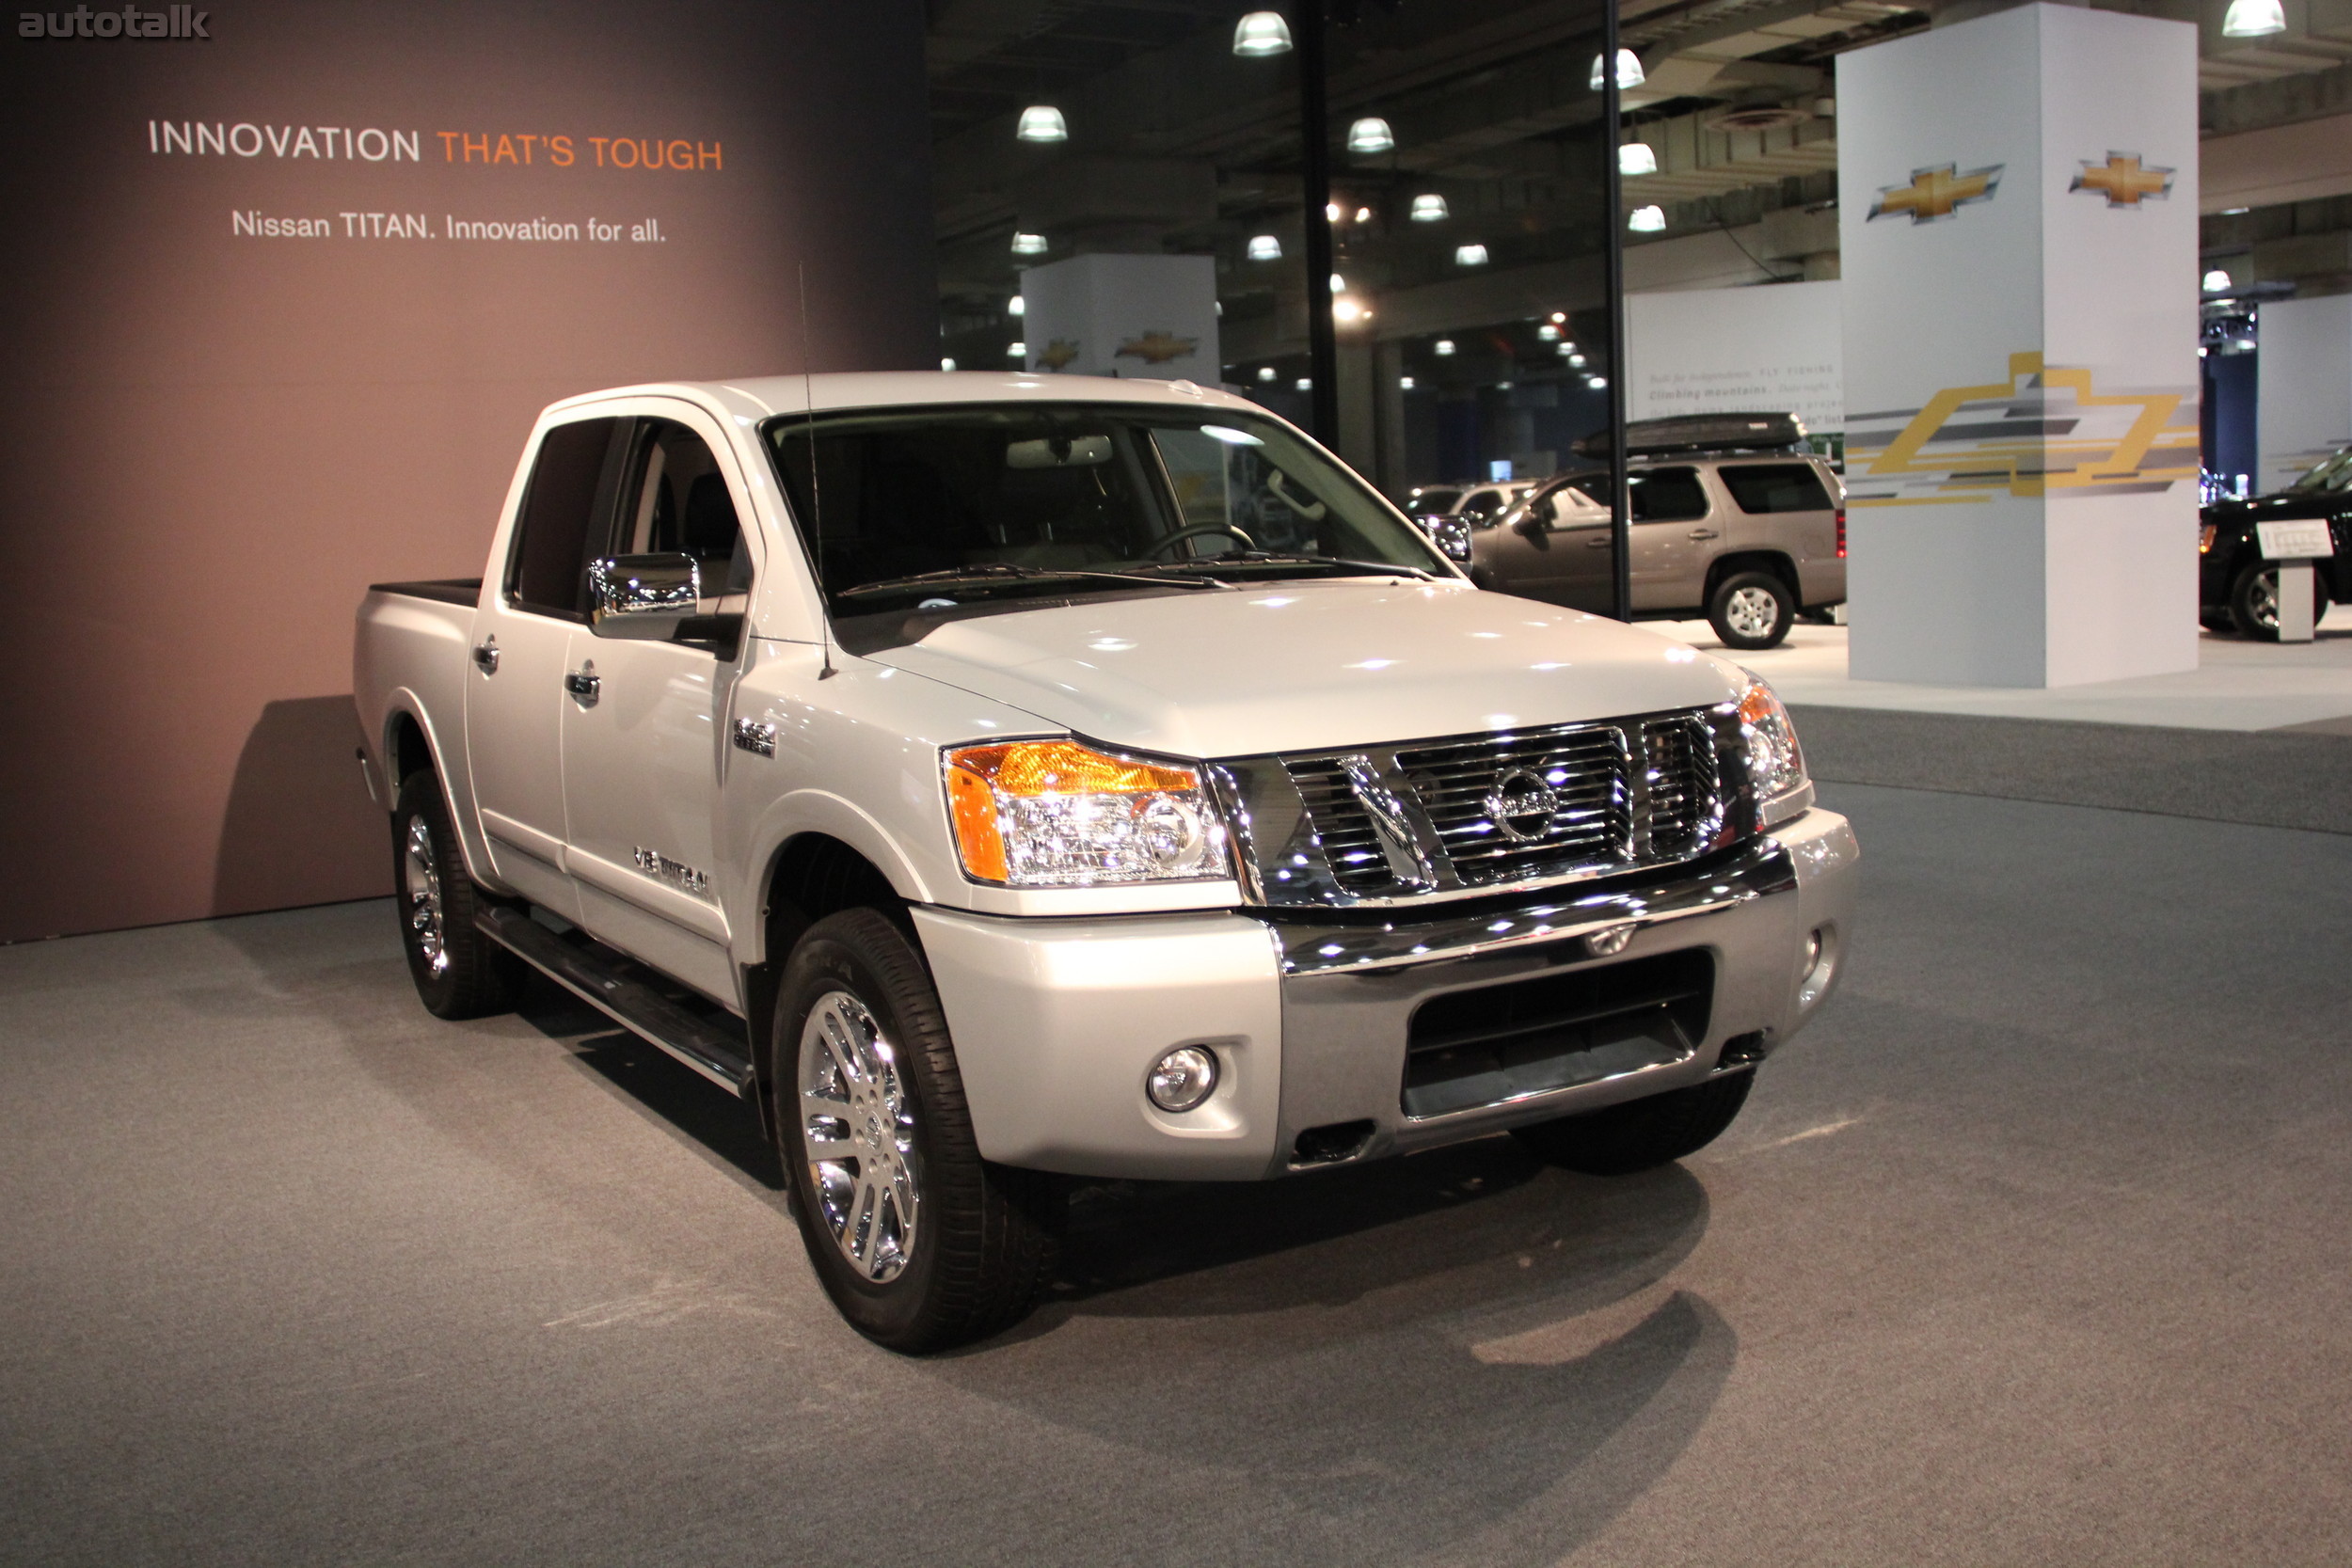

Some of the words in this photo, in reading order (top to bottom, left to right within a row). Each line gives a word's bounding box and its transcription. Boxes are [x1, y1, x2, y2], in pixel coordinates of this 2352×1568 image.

[149, 119, 420, 162] INNOVATION
[437, 131, 576, 167] THAT'S
[588, 137, 723, 171] TOUGH
[231, 209, 330, 237] Nissan
[340, 212, 436, 239] TITAN.
[447, 214, 579, 241] Innovation
[587, 216, 623, 242] for
[631, 217, 666, 243] all.
[1787, 363, 1834, 376] FISHING
[1649, 388, 1701, 402] Climbing
[1704, 385, 1773, 398] mountains.
